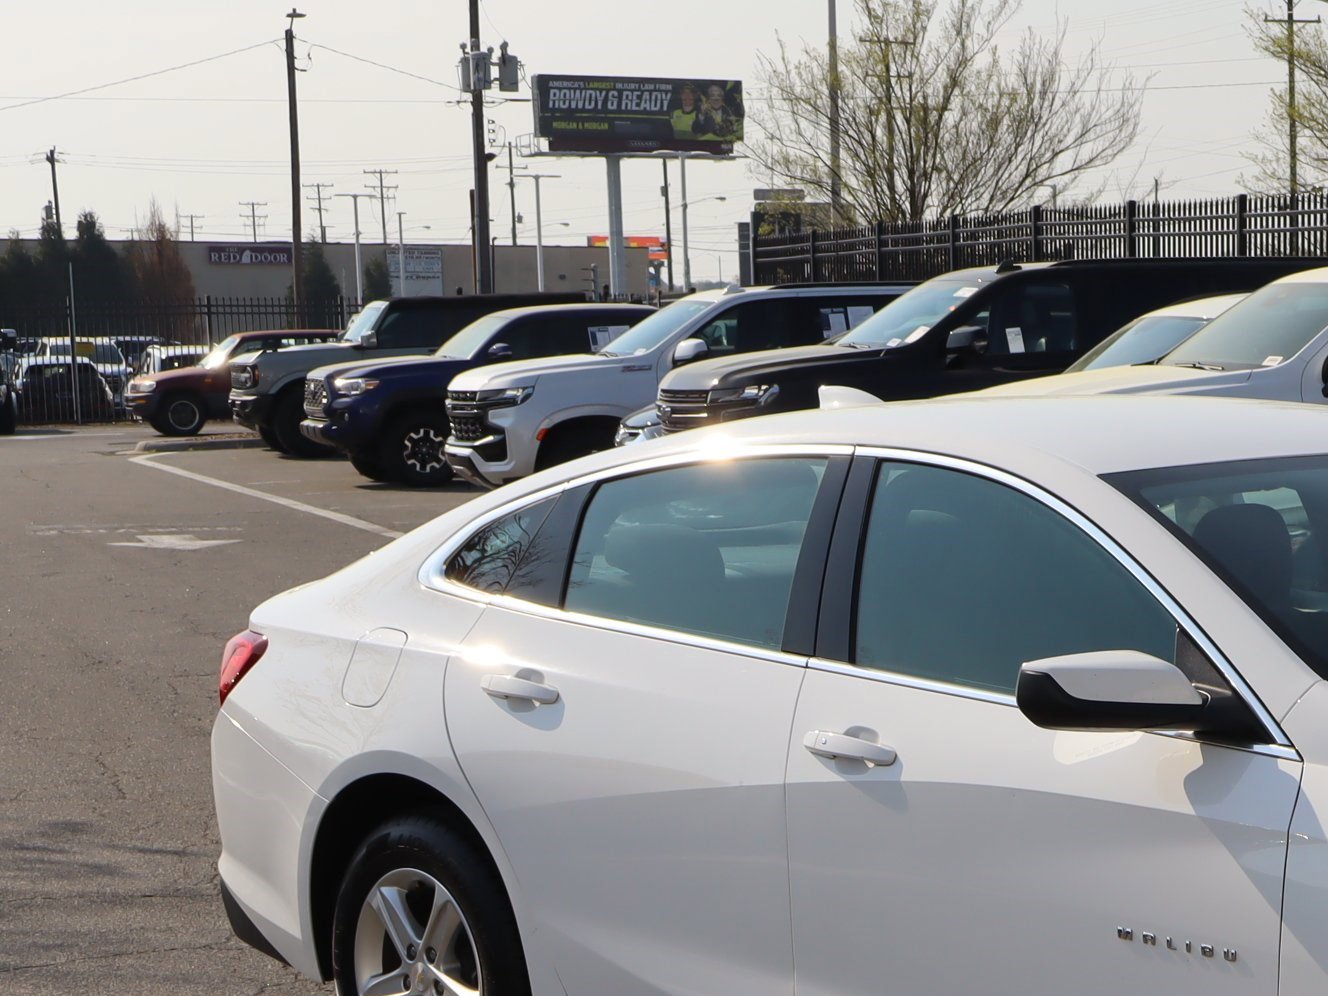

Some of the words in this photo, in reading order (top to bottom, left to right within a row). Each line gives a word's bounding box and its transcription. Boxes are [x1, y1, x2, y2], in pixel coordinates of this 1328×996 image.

[548, 89, 605, 110] ROWDY
[607, 91, 619, 110] &
[621, 91, 673, 112] READY
[552, 121, 579, 130] MORGAN
[584, 122, 609, 130] MORGAN
[211, 252, 240, 263] RED
[252, 253, 289, 263] DOOR
[1116, 925, 1237, 962] MALIBU
